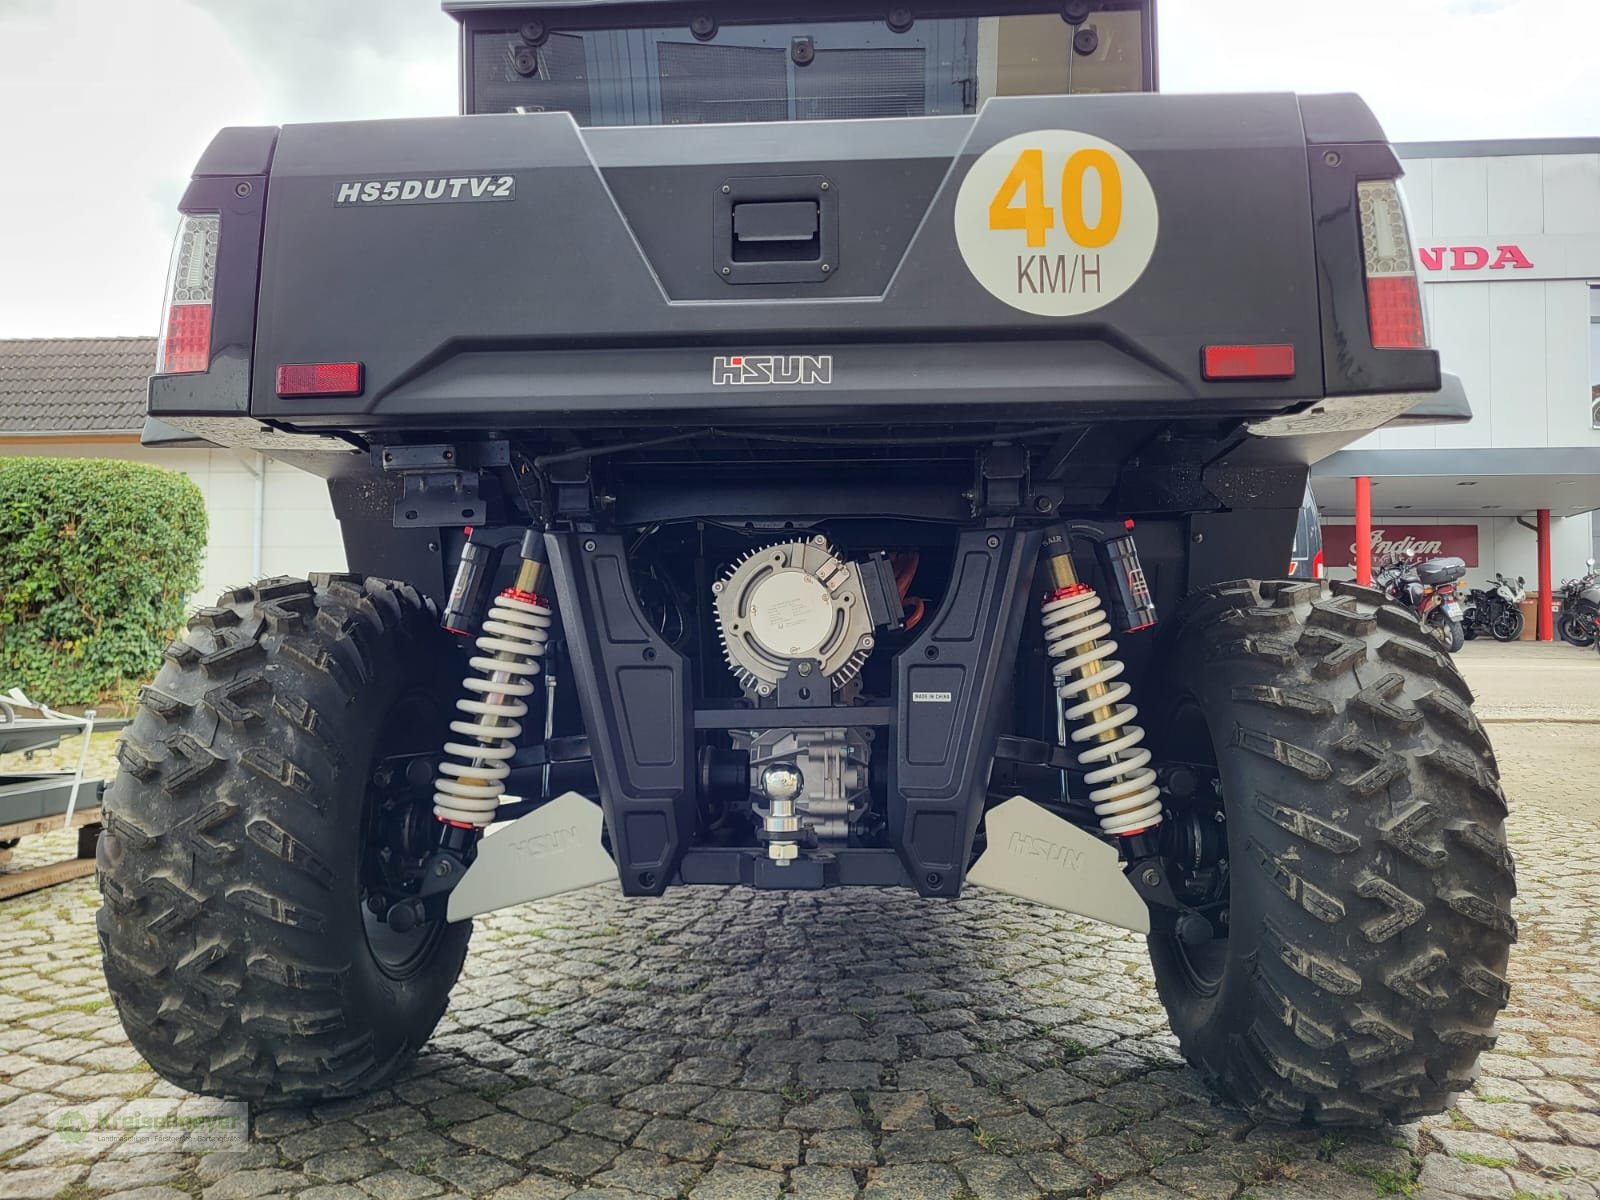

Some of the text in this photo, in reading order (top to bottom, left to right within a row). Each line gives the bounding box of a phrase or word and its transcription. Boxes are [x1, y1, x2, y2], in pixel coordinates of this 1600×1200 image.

[336, 175, 514, 203] HS5DUTV-2
[988, 147, 1123, 249] 40
[1016, 253, 1101, 295] KM/H
[712, 355, 832, 385] HSUN
[1008, 831, 1085, 872] HSUN
